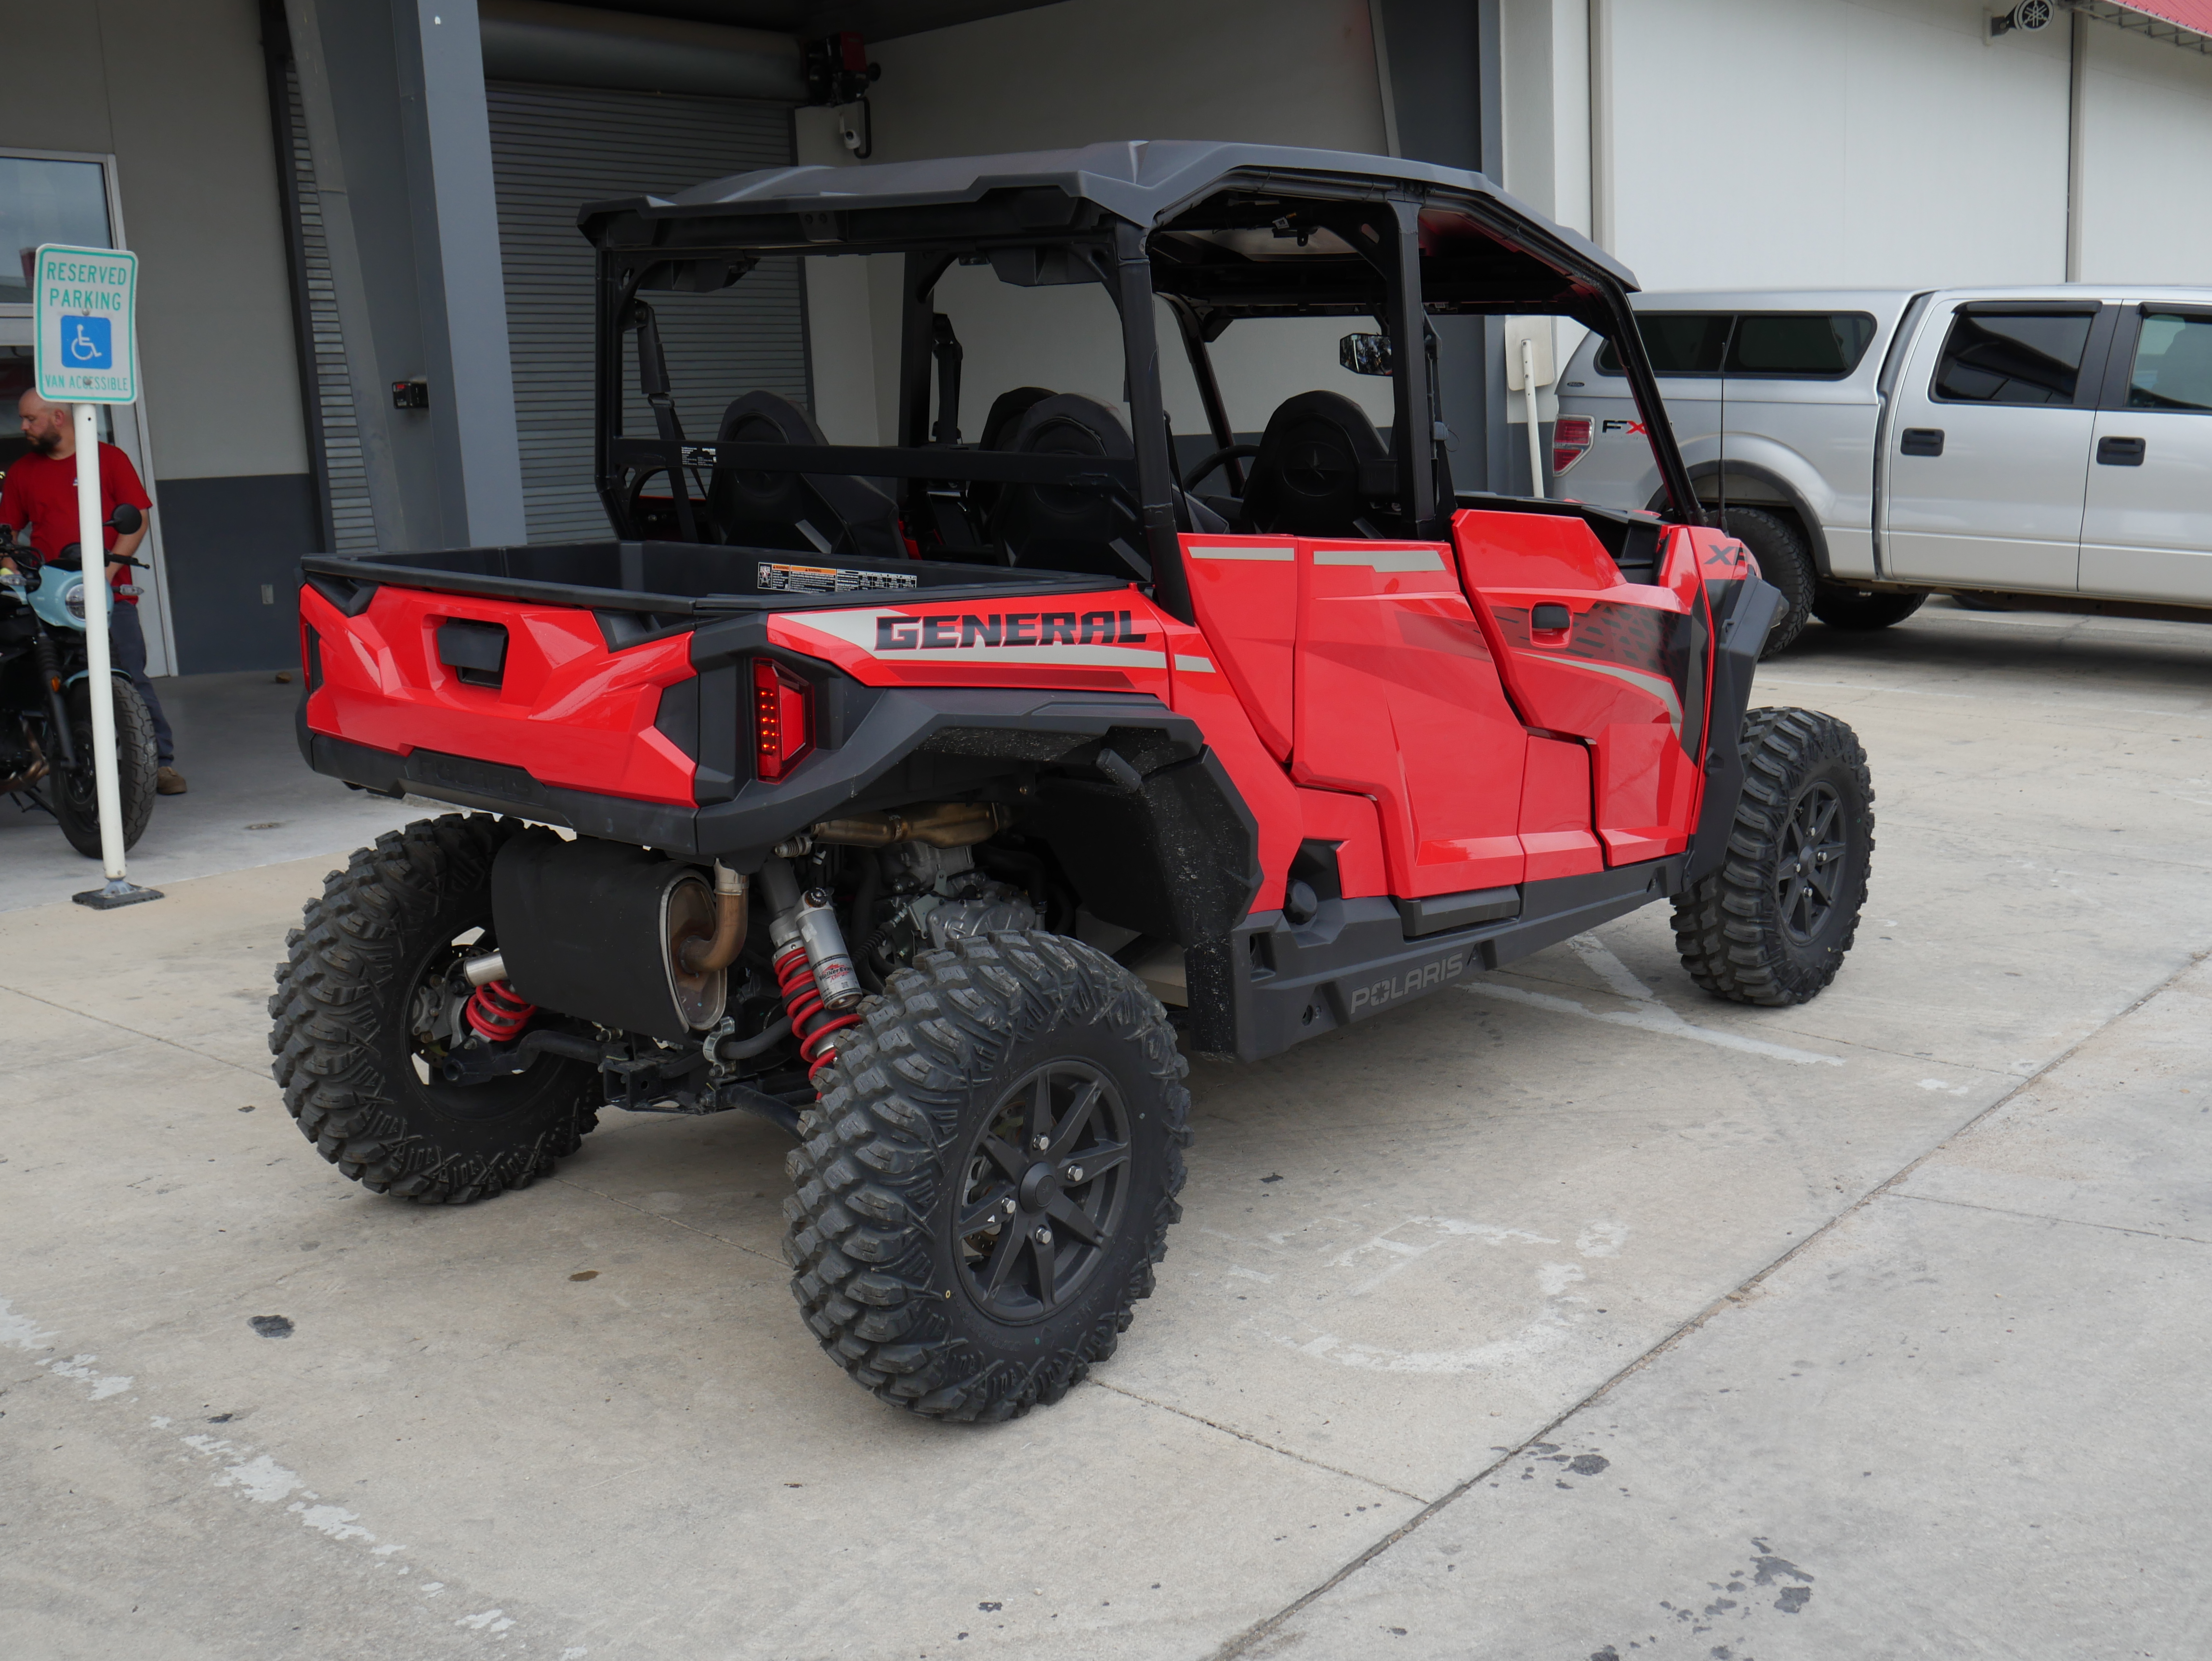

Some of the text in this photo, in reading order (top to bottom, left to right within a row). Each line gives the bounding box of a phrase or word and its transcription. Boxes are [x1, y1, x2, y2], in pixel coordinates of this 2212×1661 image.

[47, 262, 127, 286] RESERVED
[49, 288, 121, 311] PARKING
[45, 375, 128, 391] VAN ACCESSIBLE
[1602, 420, 1648, 435] FX
[873, 610, 1147, 651] GENERAL
[819, 968, 840, 981] Walker
[1351, 950, 1463, 1014] POLARIS
